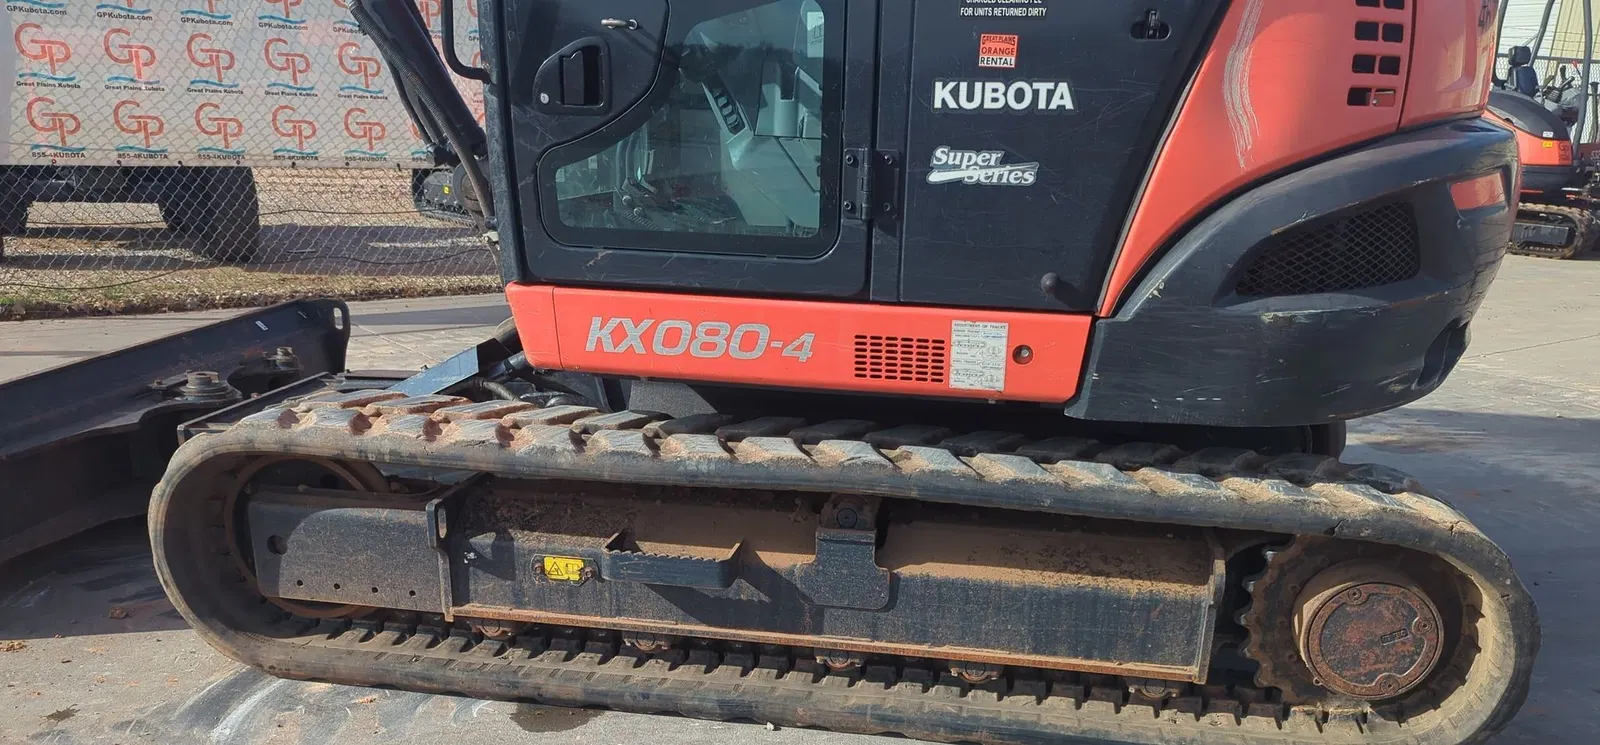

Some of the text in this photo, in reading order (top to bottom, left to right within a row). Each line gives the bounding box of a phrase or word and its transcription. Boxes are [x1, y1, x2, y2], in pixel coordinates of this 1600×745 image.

[6, 5, 67, 15] GPKubota.com
[960, 7, 1047, 17] FOR UNITS RETURNED DIRTY
[97, 12, 153, 21] GPKubota.com
[181, 17, 233, 26] GPKubota.com
[258, 22, 308, 30] GPKubota.com
[982, 35, 1016, 46] GREAT PLAINS
[980, 46, 1016, 56] ORANGE
[979, 56, 1014, 66] RENTAL
[933, 81, 1074, 110] KUBOTA
[31, 151, 87, 159] 855-4KUBOTA
[117, 152, 169, 160] 855-4KUBOTA
[932, 147, 1002, 170] Super
[963, 166, 1035, 184] Series
[585, 316, 816, 363] KX080-4
